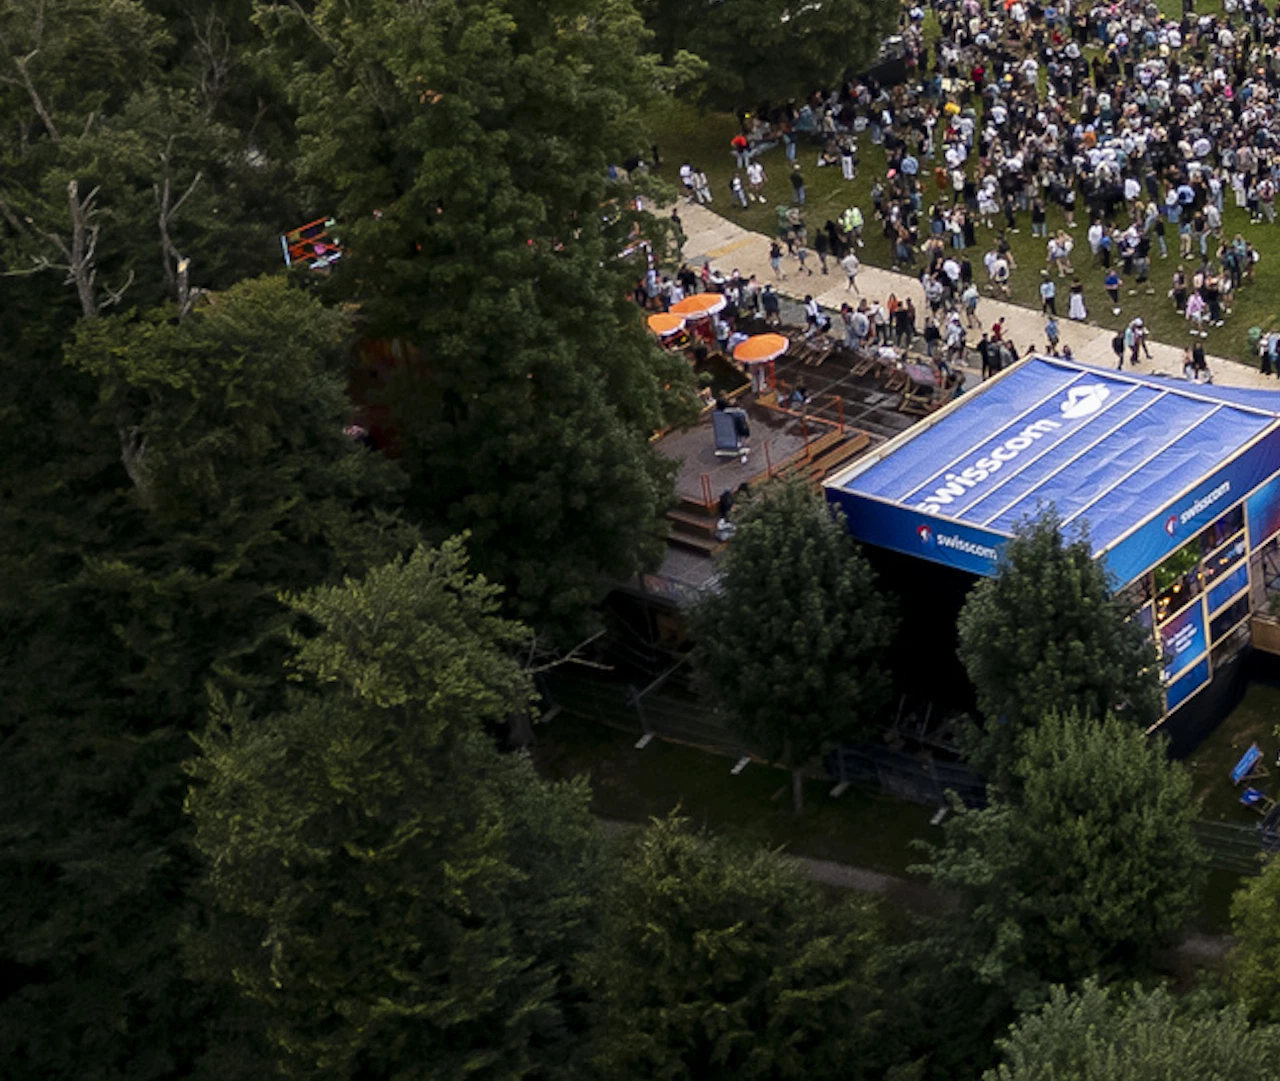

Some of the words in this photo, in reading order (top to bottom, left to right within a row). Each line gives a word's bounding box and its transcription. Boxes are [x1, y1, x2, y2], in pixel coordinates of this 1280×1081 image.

[915, 419, 1062, 515] swisscom
[1180, 481, 1231, 525] swisscom
[936, 533, 998, 561] swisscom
